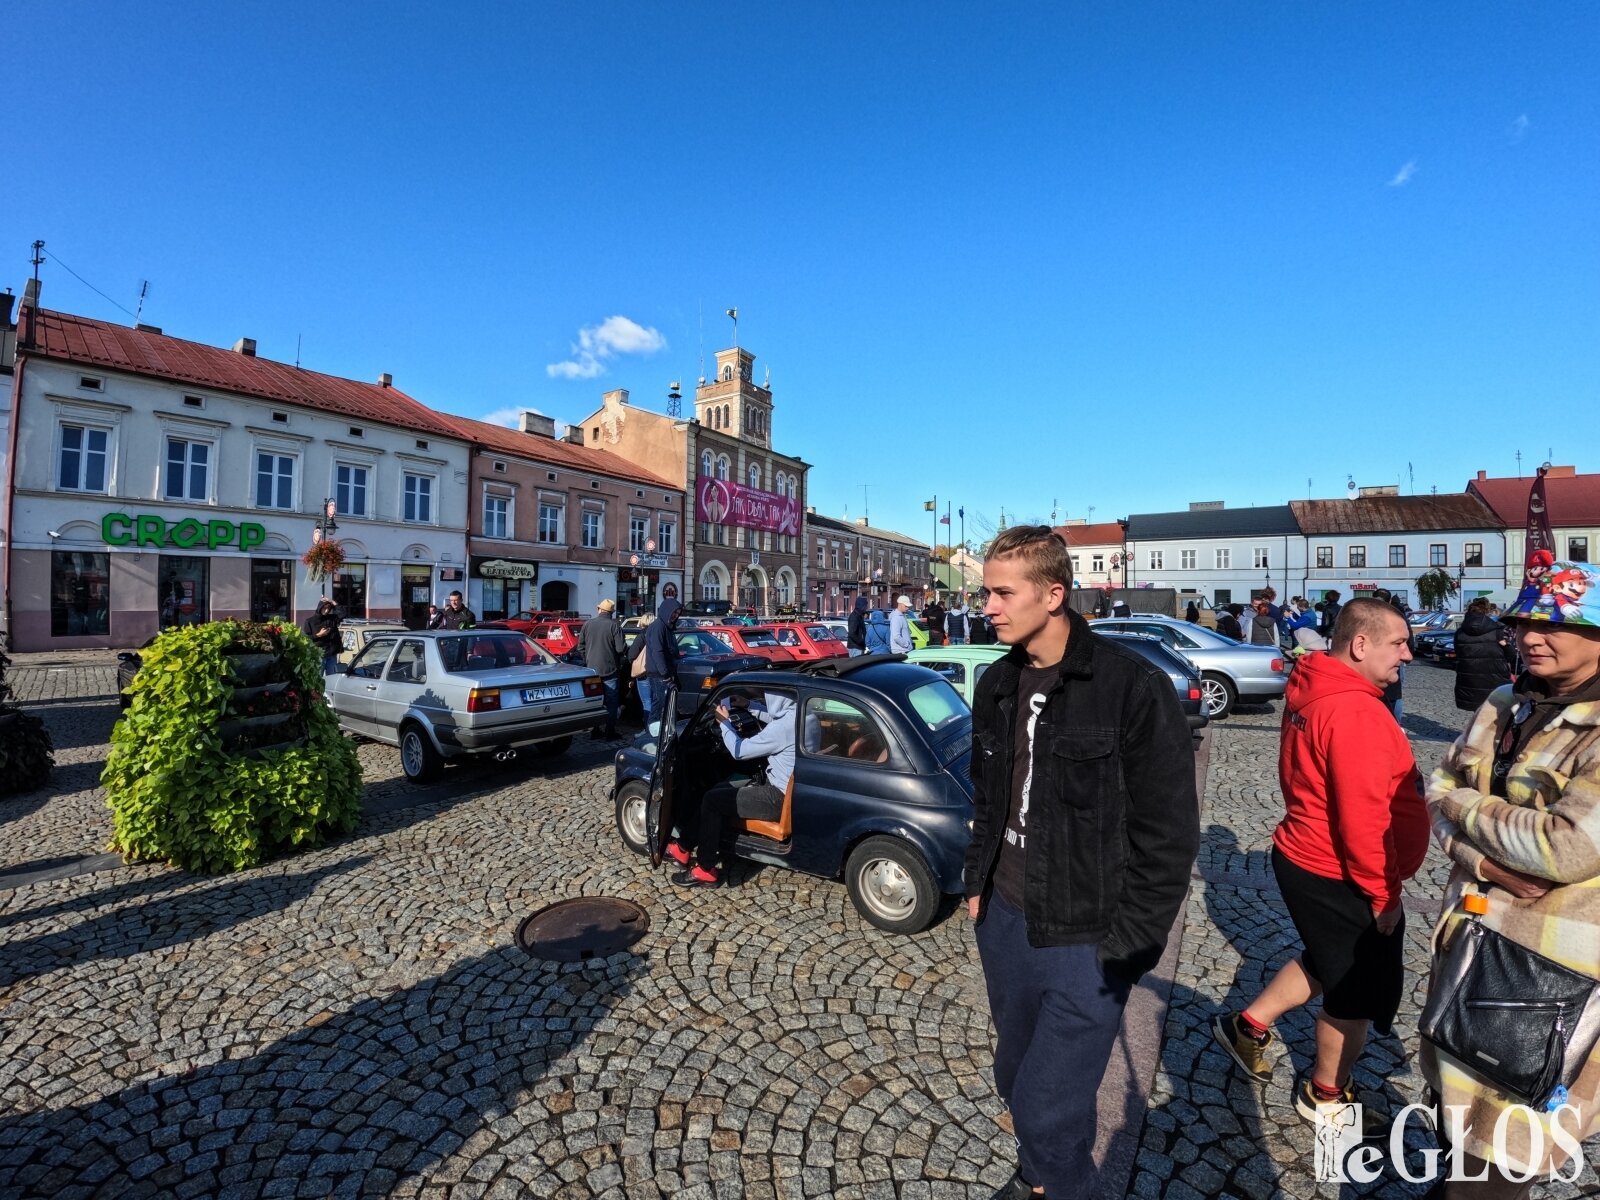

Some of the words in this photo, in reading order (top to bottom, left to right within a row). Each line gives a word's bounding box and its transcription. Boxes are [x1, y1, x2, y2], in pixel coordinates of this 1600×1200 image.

[731, 496, 745, 515] JAK
[769, 504, 781, 522] TAK
[101, 512, 266, 551] CROPP
[1350, 582, 1378, 590] mBank
[527, 689, 546, 701] WZY
[547, 684, 569, 697] YU36
